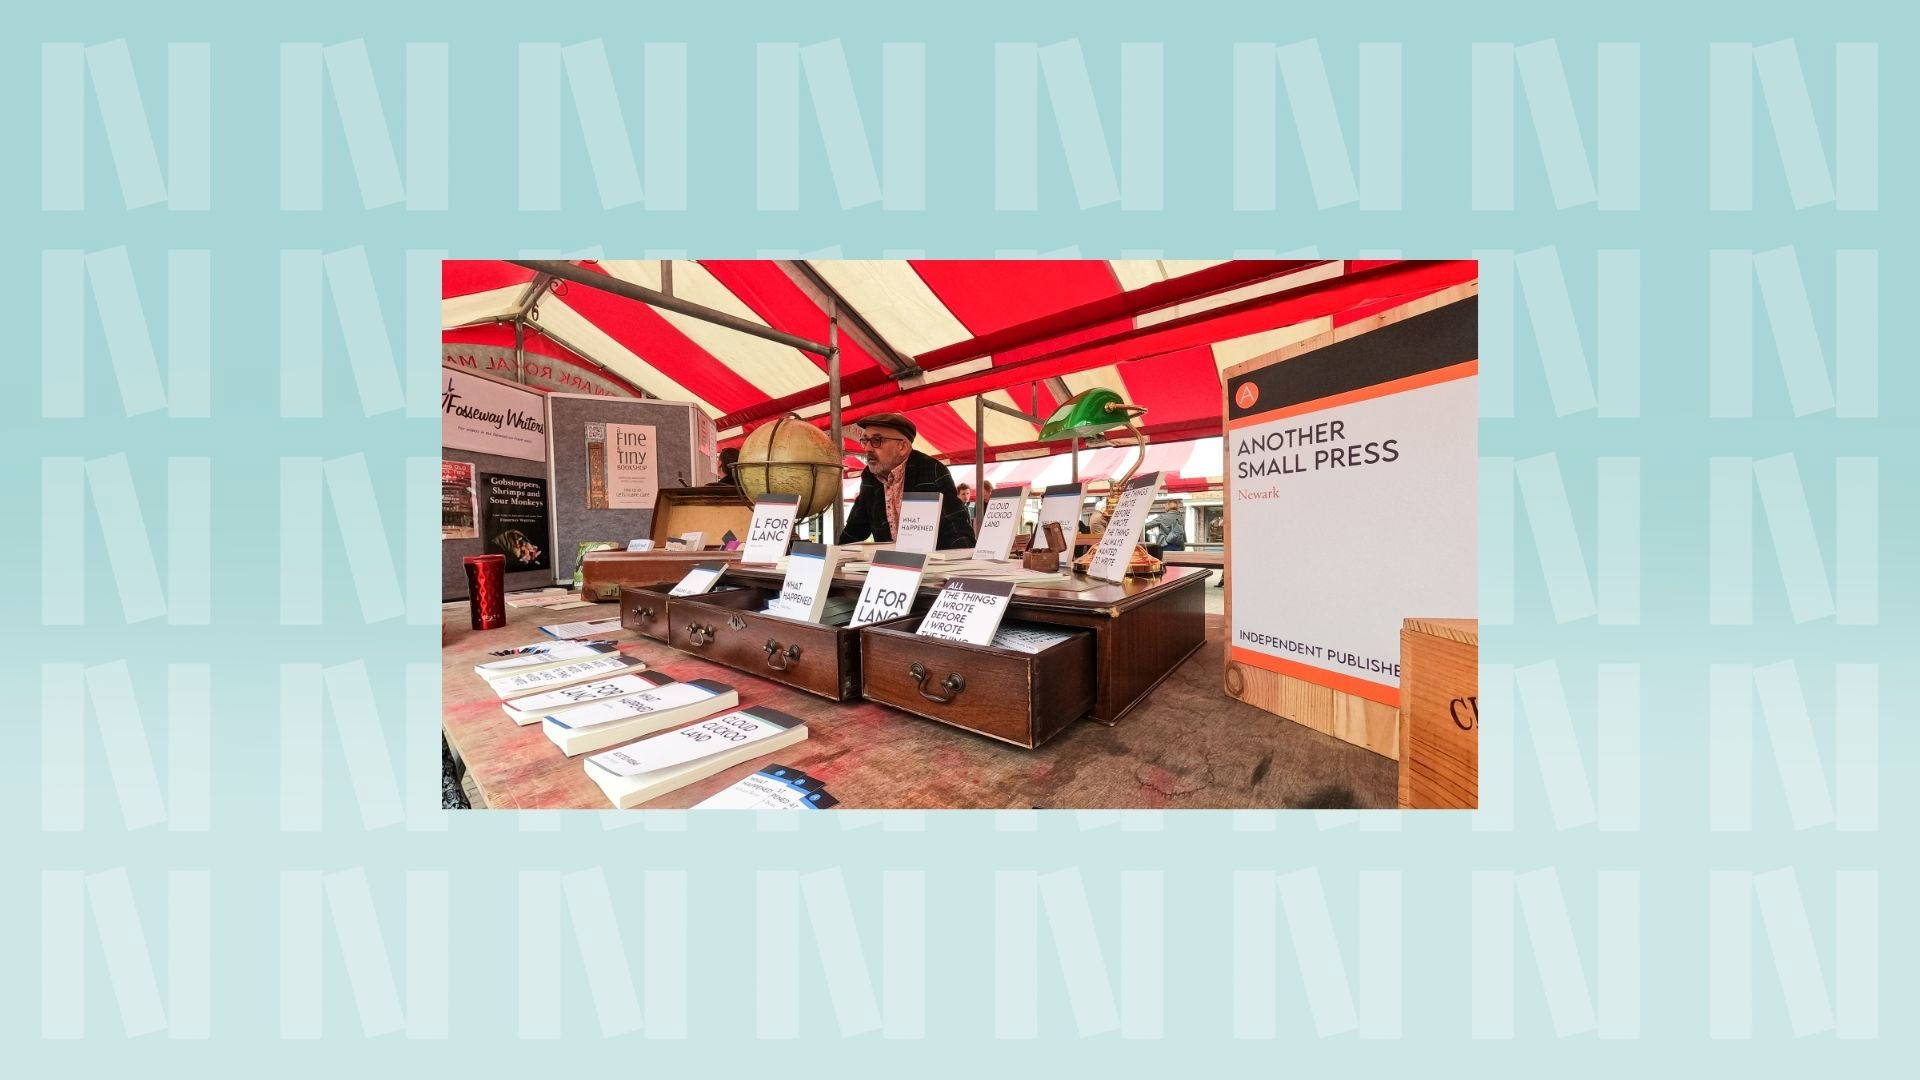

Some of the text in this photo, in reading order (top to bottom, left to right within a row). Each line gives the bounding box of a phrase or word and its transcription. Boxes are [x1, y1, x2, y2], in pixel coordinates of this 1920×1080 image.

[1239, 384, 1256, 405] A
[446, 394, 544, 435] Fosseway Writers
[1237, 420, 1346, 457] ANOTHER
[1237, 439, 1400, 479] SMALL PRESS
[490, 476, 541, 489] Gobstoppers,
[492, 486, 541, 498] Shrimps and
[1237, 486, 1280, 501] Newark
[489, 496, 544, 508] Sour Monkeys
[989, 502, 1010, 510] CLOUD
[986, 511, 1013, 519] CUCKOO
[755, 518, 789, 529] L FOR
[751, 530, 785, 542] LANC
[947, 581, 965, 591] ALL
[864, 587, 907, 610] L FOR
[943, 590, 998, 606] THE THINGS
[942, 601, 976, 614] WROTE
[930, 610, 968, 624] BEFORE
[930, 621, 965, 635] WROTE
[1239, 629, 1323, 659] INDEPENDENT
[721, 716, 759, 732] CLOUD
[680, 727, 712, 742] LAND
[702, 722, 747, 741] CUCKOO
